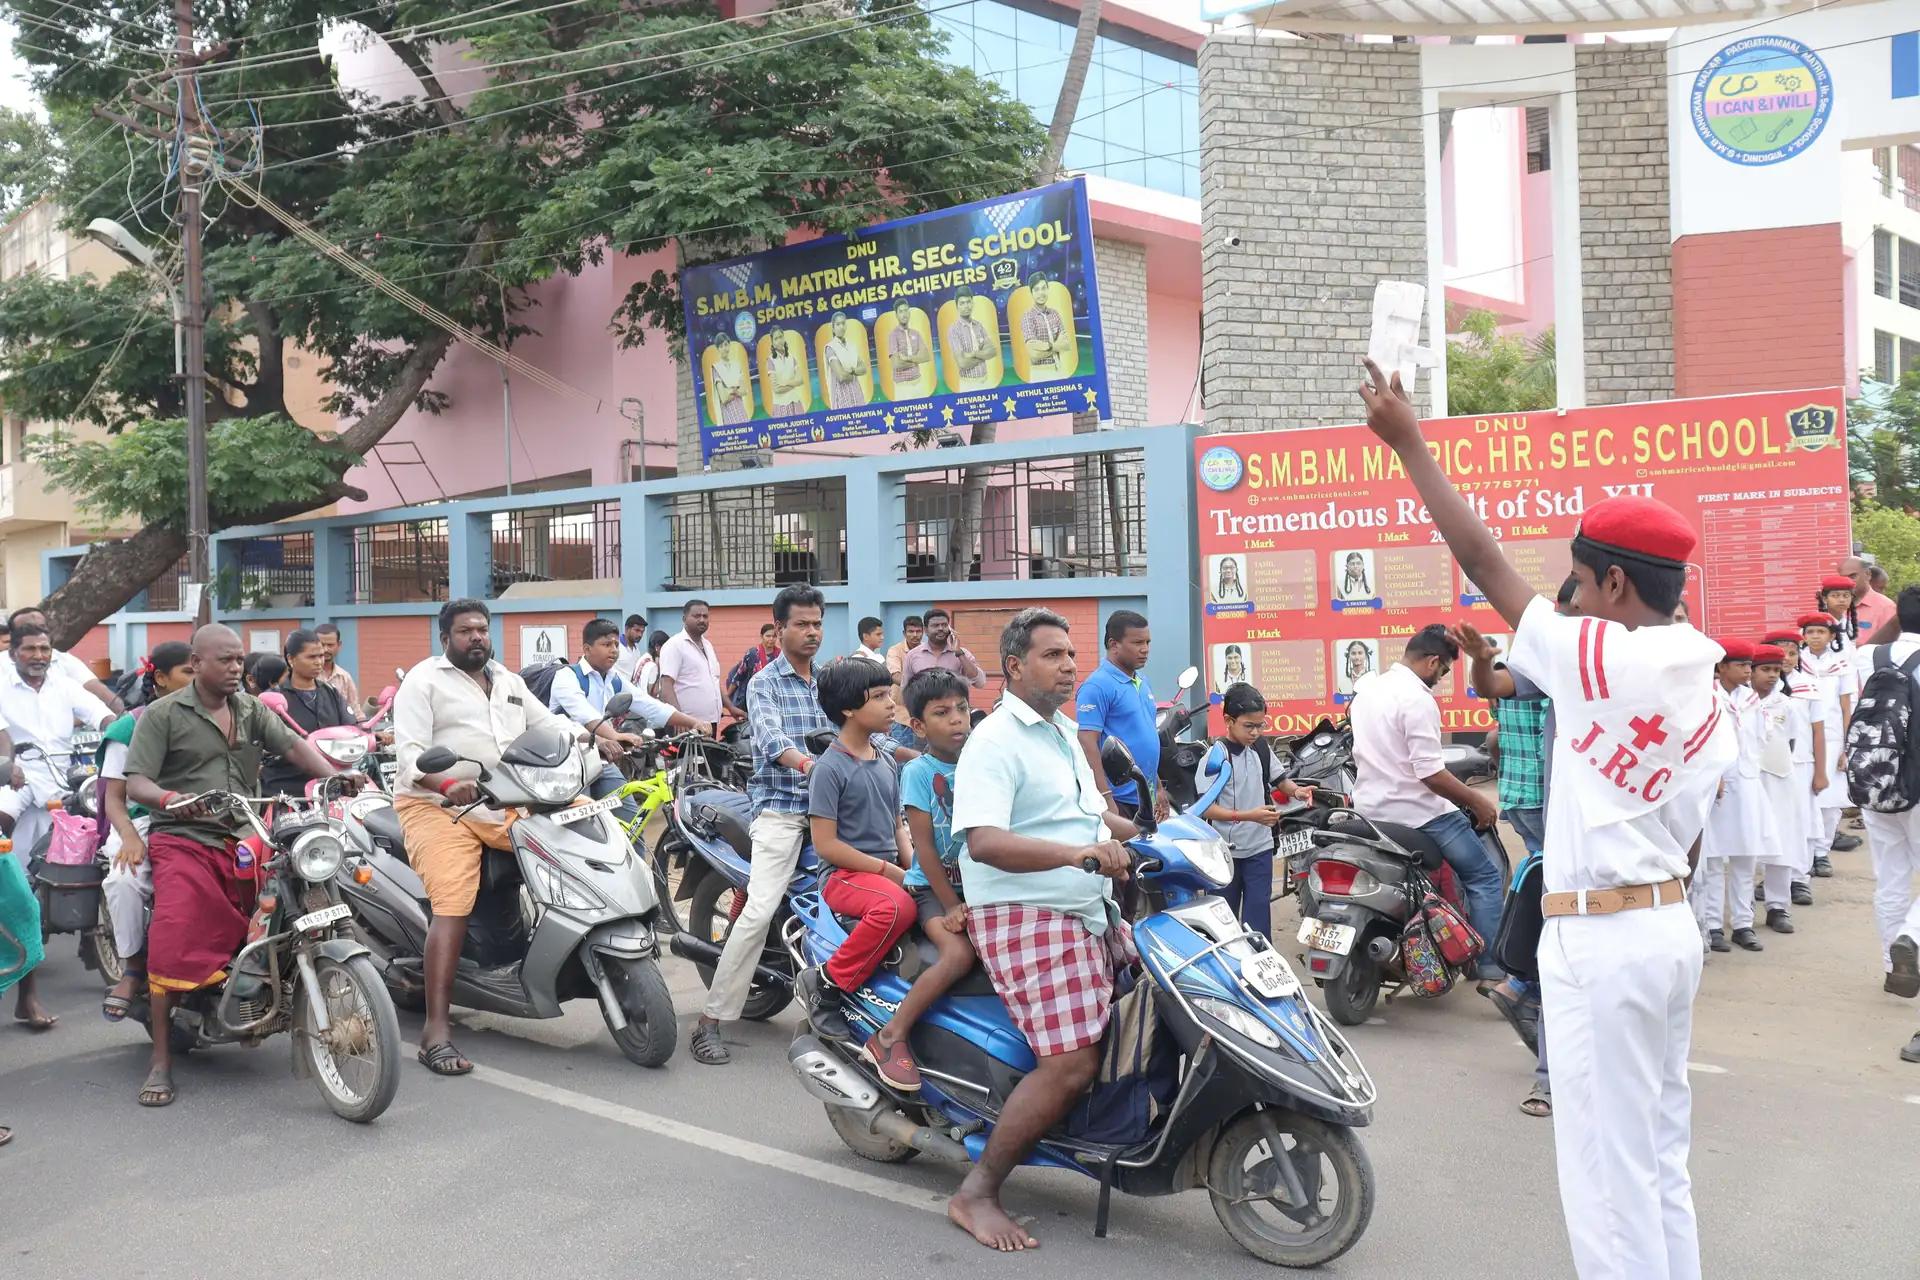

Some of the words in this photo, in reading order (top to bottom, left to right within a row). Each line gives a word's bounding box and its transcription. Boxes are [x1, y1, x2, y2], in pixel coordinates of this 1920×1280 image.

[1723, 102, 1755, 115] CAN
[1777, 93, 1812, 109] WILL
[781, 264, 865, 298] MATRIC.
[869, 255, 908, 280] HR.
[911, 244, 963, 271] SEC.
[968, 220, 1072, 260] SCHOOL
[847, 241, 877, 260] DNU
[997, 263, 1013, 275] 42
[757, 300, 814, 324] SPORTS
[817, 297, 829, 312] &
[831, 284, 888, 309] GAMES
[892, 265, 988, 298] ACHIEVERS
[1475, 416, 1528, 433] DNU
[1797, 411, 1826, 429] 43
[1247, 447, 1355, 489] S.M.B.M.
[1697, 493, 1729, 503] FIRST
[1733, 490, 1766, 500] MARK
[1769, 489, 1781, 498] IN
[1784, 486, 1842, 497] SUBJECTS
[1210, 501, 1388, 536] Tremendous
[1497, 489, 1530, 519] of
[1536, 485, 1584, 517] Std
[1385, 532, 1409, 542] Mark
[1522, 525, 1548, 535] Mark
[1251, 538, 1275, 549] Mark
[1257, 629, 1281, 638] Mark
[1391, 625, 1416, 634] Mark
[560, 813, 570, 822] TN
[579, 807, 588, 816] 52
[601, 798, 618, 809] 7123
[1280, 830, 1308, 845] TN57B
[1314, 926, 1328, 938] TN
[1328, 930, 1340, 940] 57
[1319, 937, 1342, 950] 3037
